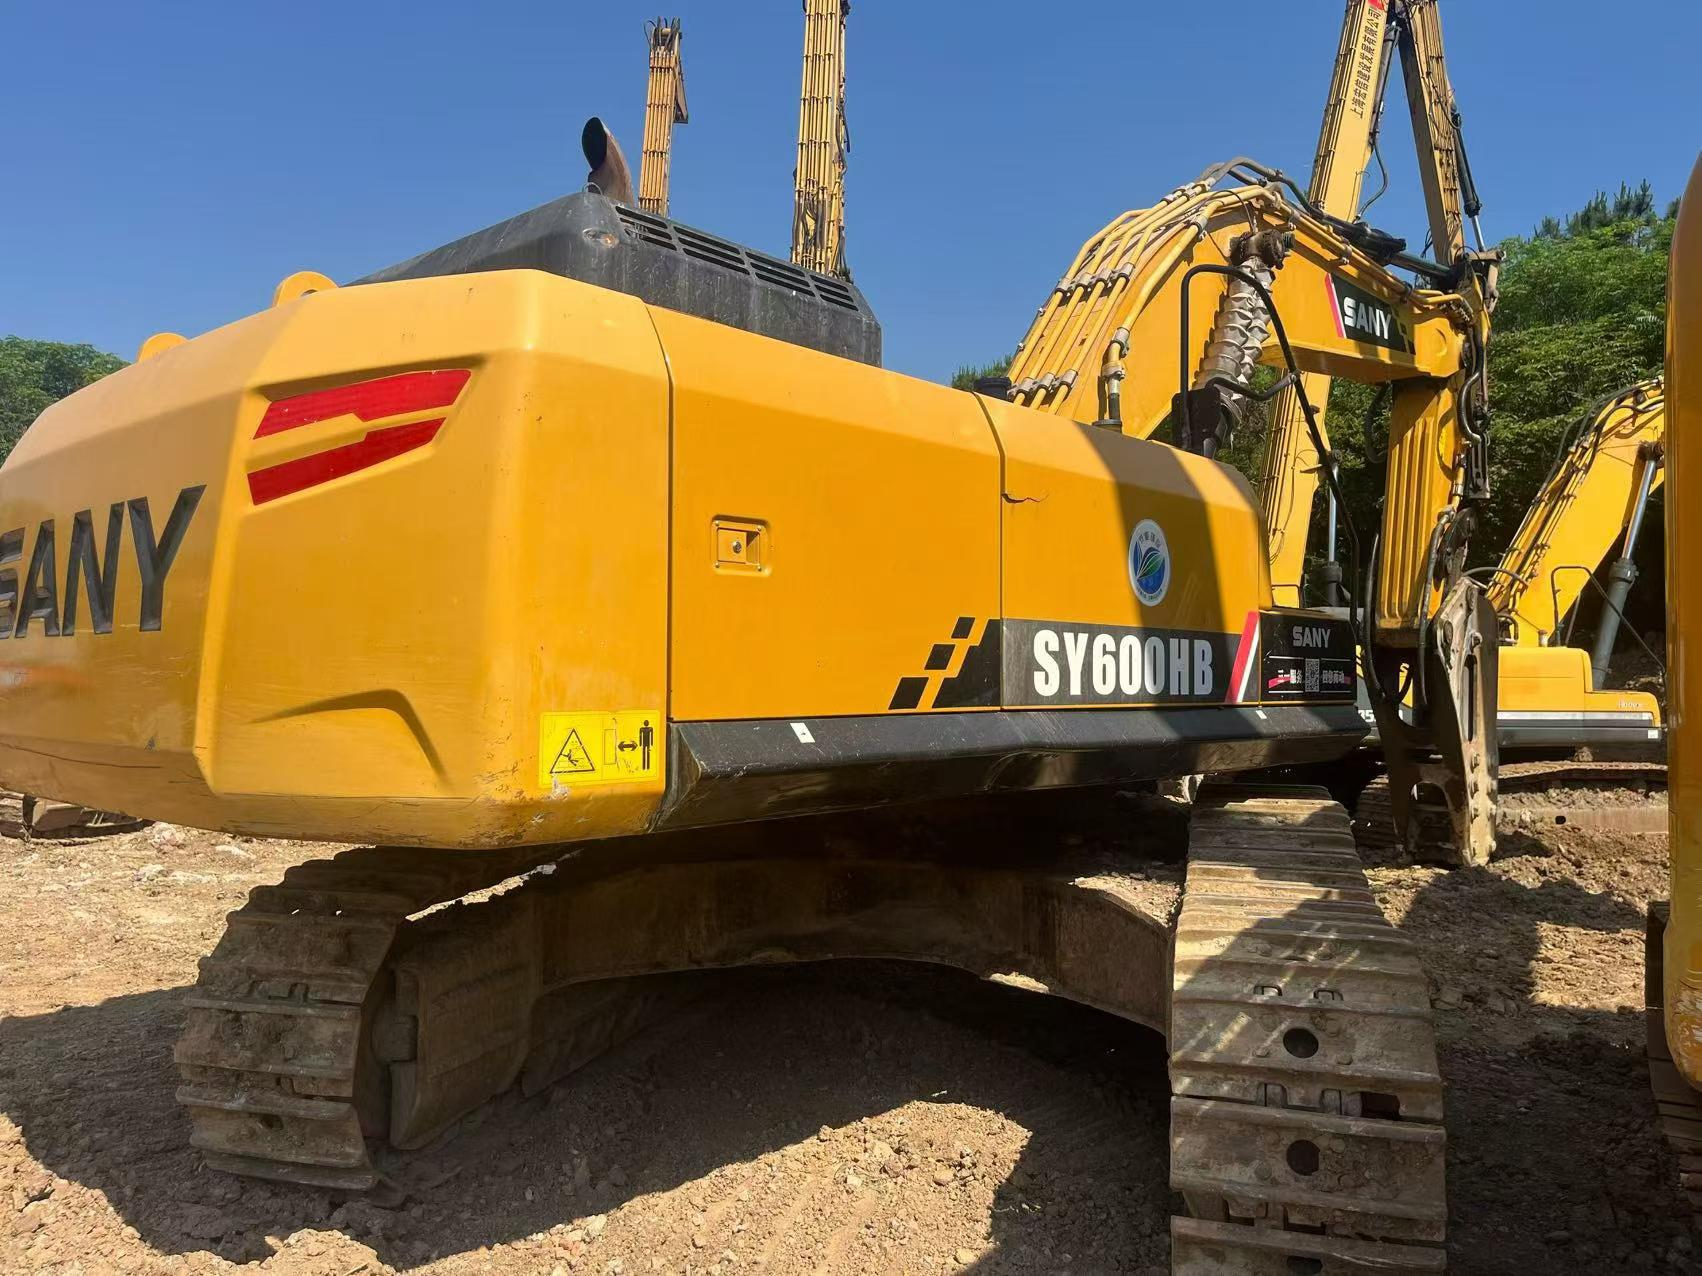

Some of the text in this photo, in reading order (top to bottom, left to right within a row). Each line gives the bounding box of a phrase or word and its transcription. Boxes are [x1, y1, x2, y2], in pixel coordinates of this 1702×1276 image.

[1350, 8, 1382, 119] 上海宏信建设发展有限公司
[1343, 296, 1392, 340] SANY
[1033, 629, 1213, 697] SY600HB
[1292, 625, 1331, 649] SANY
